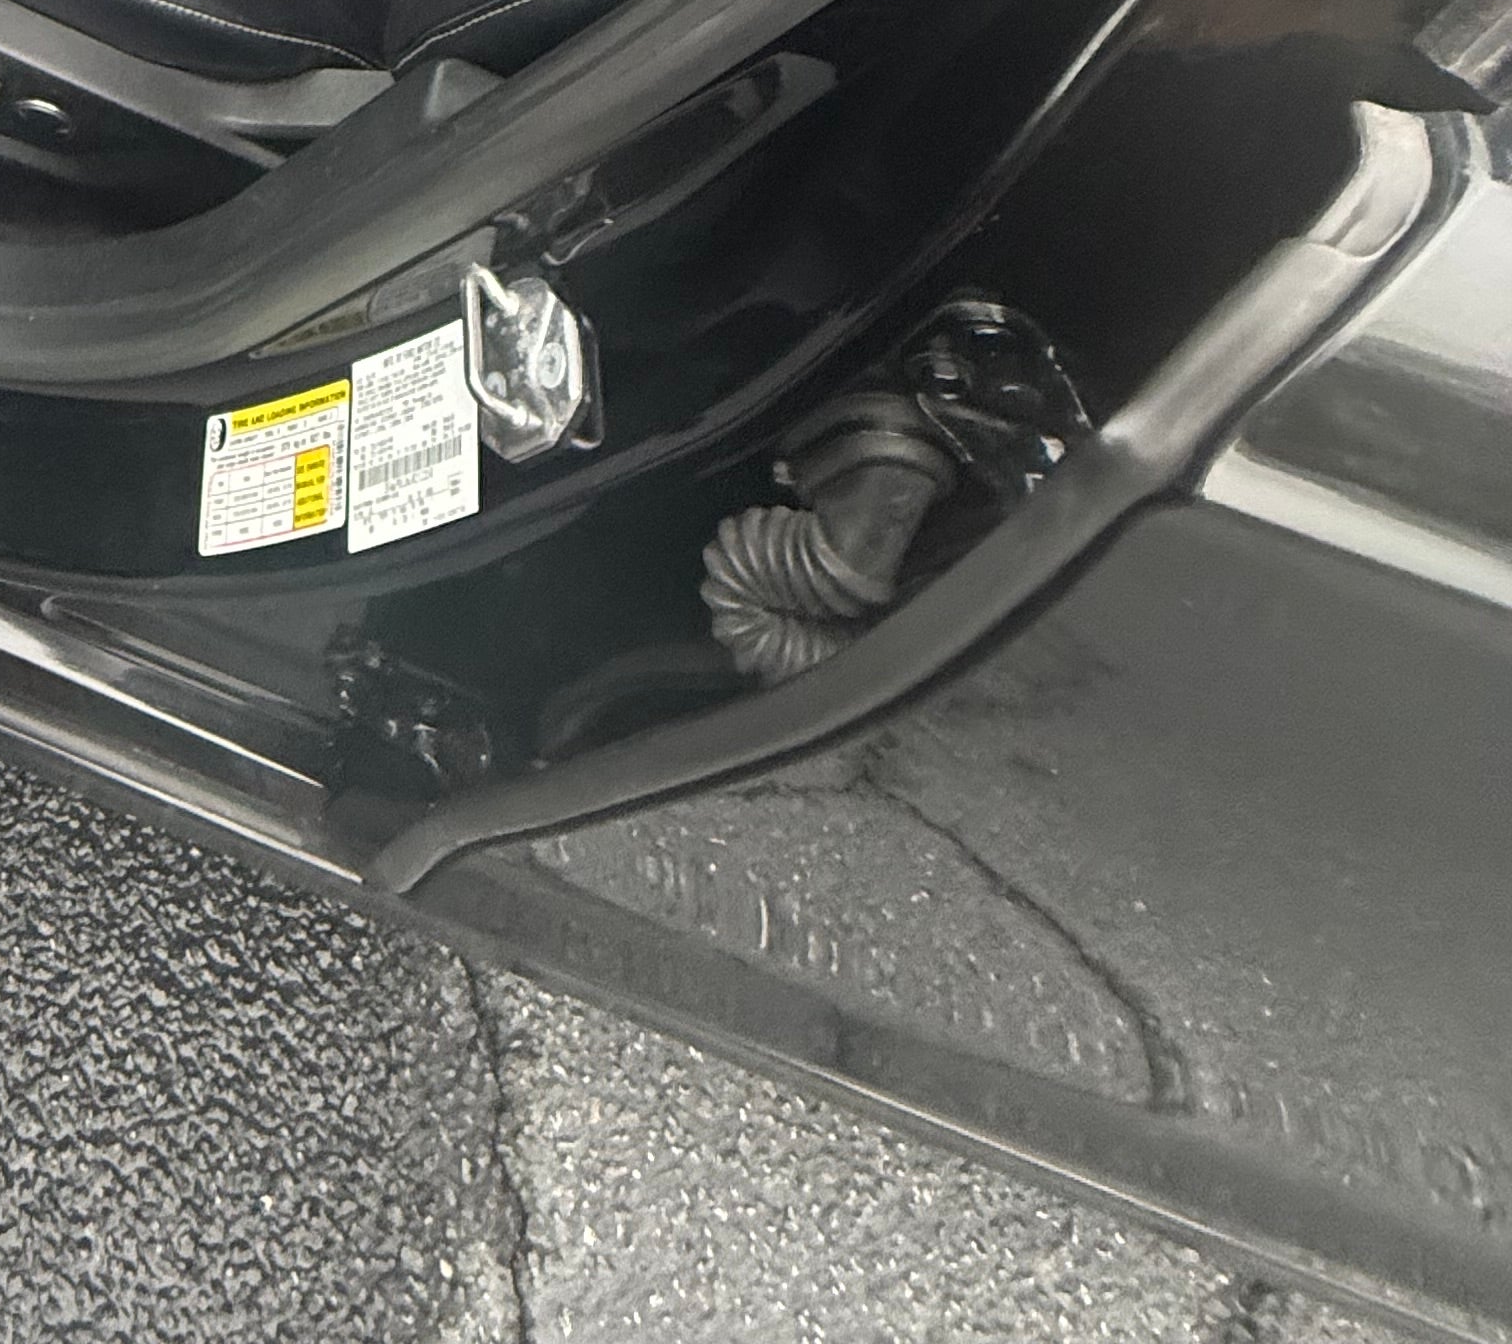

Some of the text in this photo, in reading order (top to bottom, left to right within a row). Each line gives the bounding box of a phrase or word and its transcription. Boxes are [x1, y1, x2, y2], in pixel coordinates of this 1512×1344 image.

[232, 417, 249, 429] TIRE
[266, 404, 297, 422] LOADING
[299, 390, 346, 412] INFORMATION
